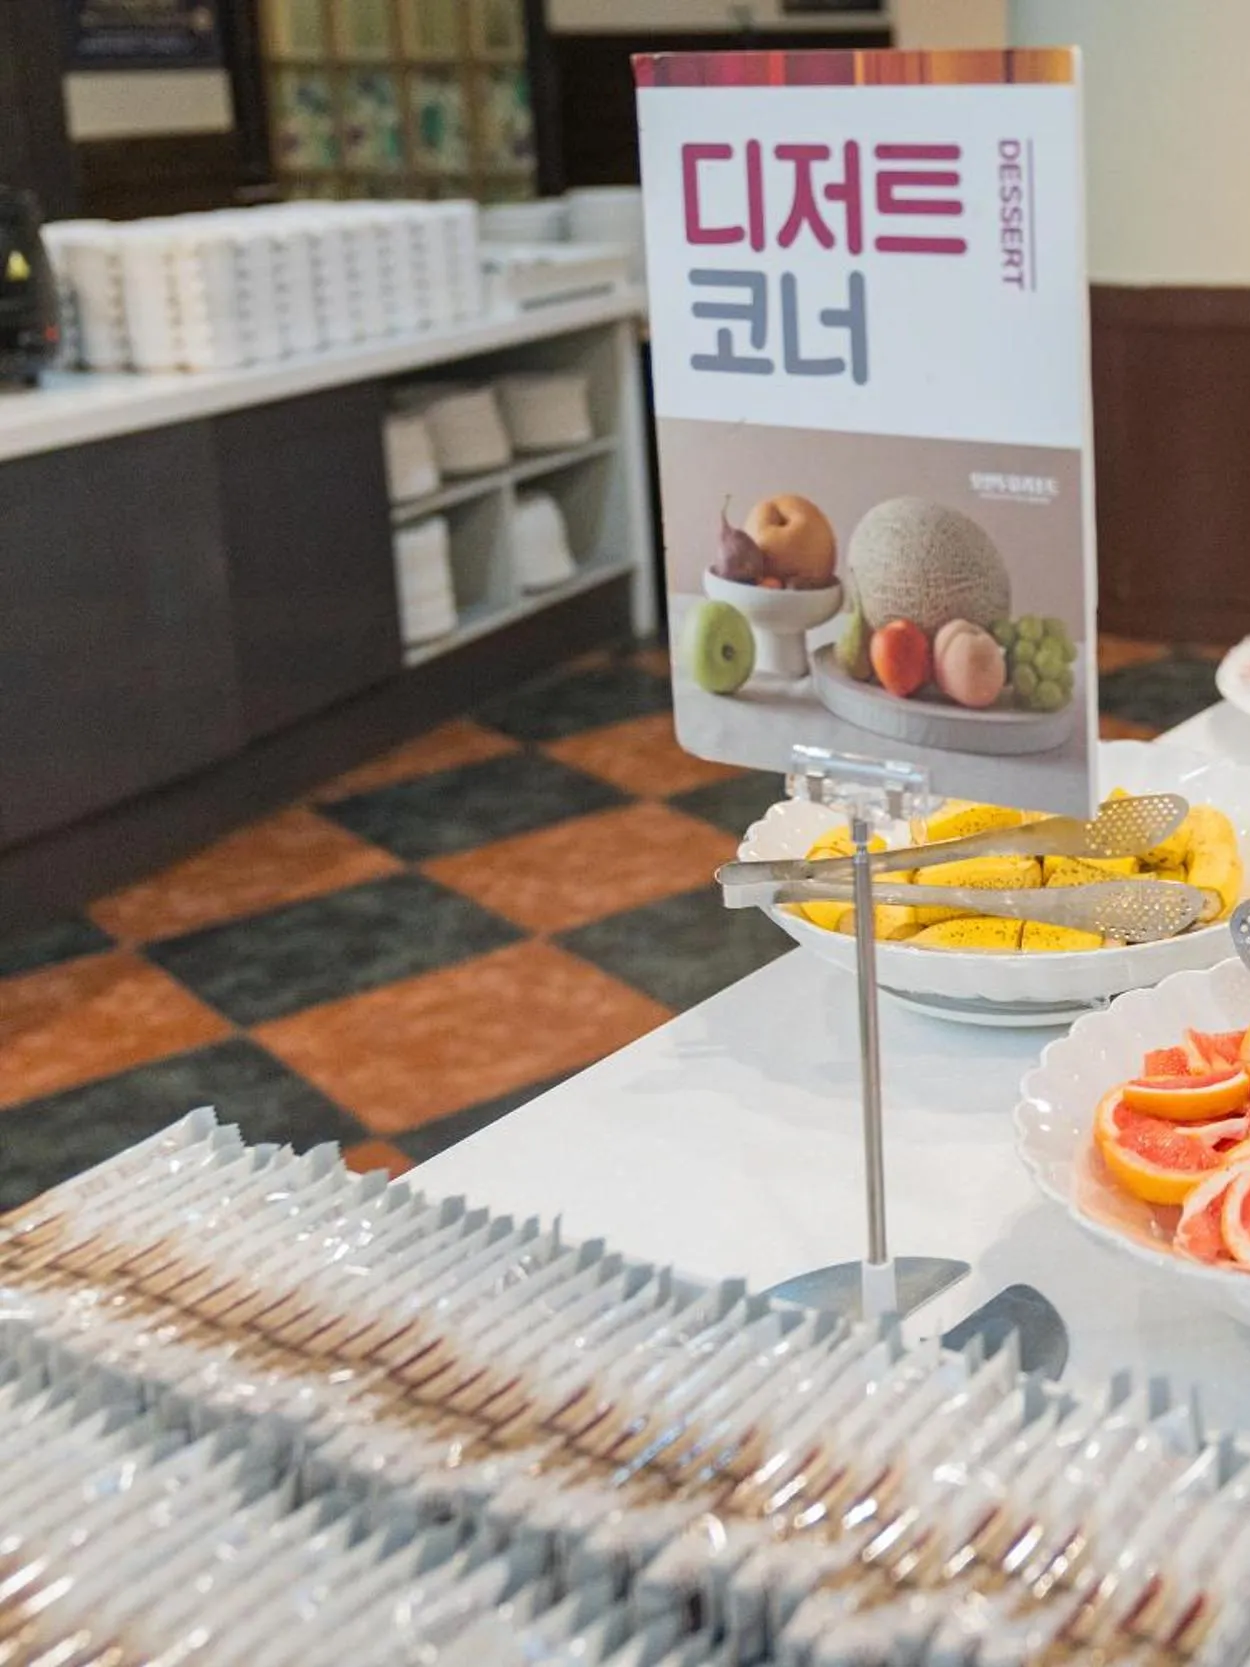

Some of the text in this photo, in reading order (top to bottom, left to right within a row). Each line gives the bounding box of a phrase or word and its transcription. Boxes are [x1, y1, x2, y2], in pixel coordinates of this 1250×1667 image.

[682, 140, 967, 256] 디저트
[998, 139, 1024, 289] DESSERT
[688, 269, 869, 386] 코너
